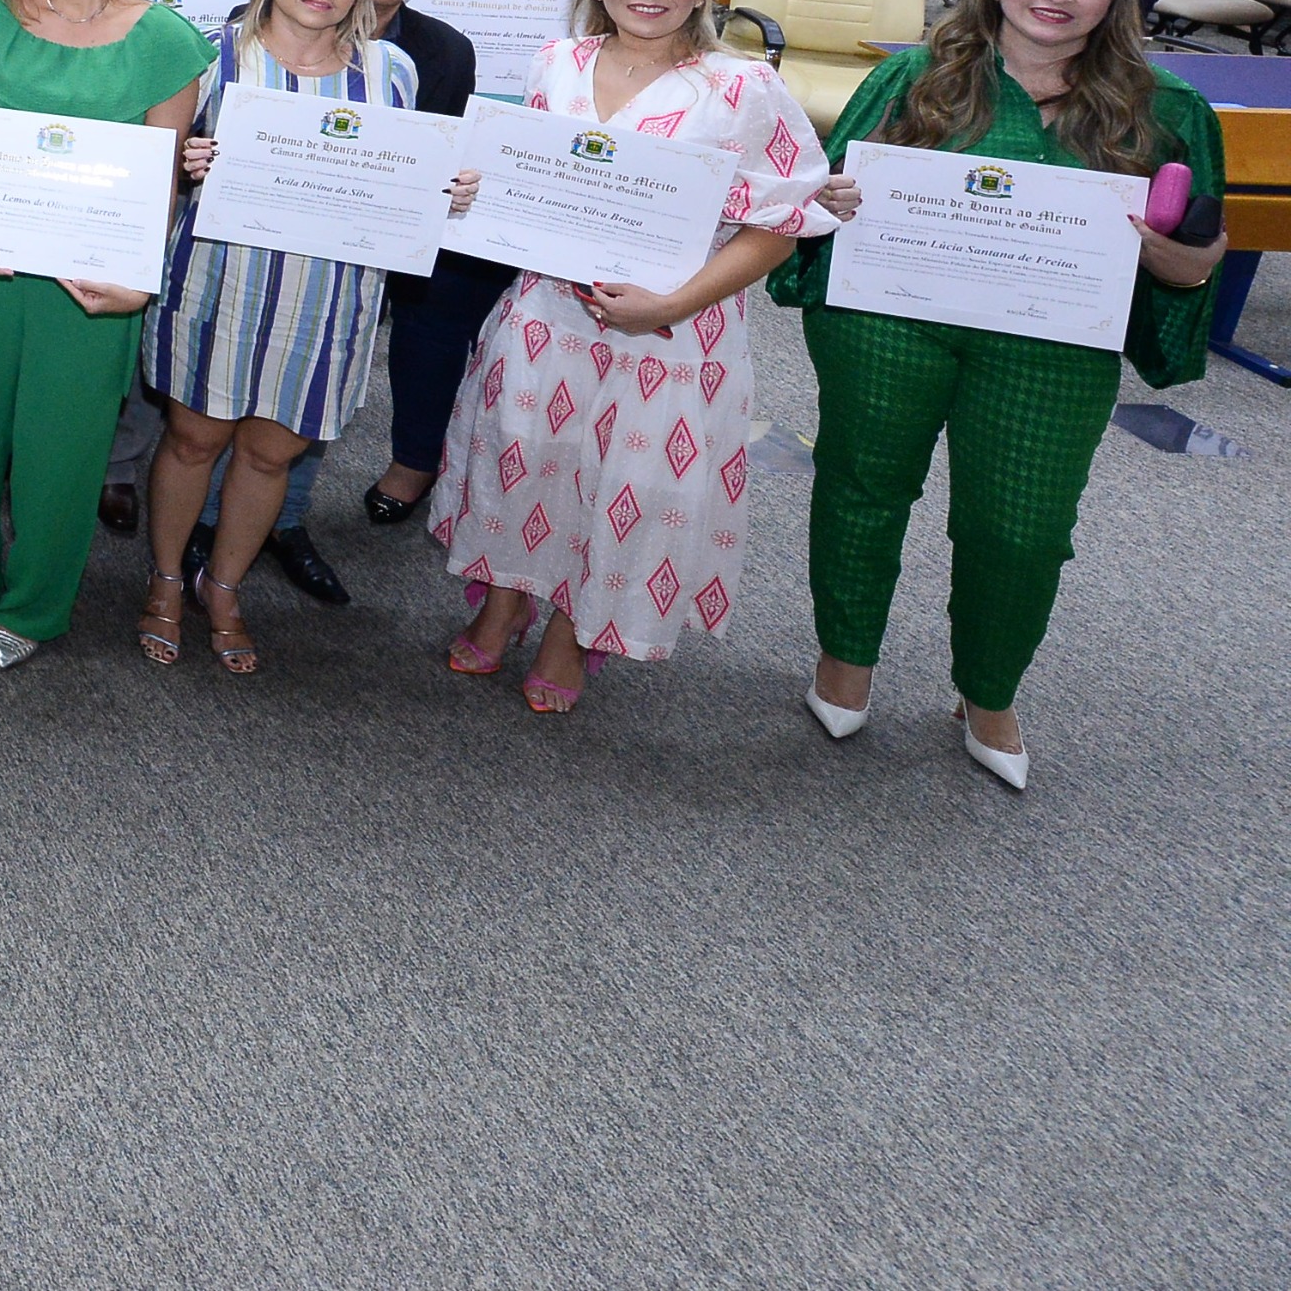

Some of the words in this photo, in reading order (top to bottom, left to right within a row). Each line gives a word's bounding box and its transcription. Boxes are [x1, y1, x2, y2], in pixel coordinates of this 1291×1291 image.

[274, 176, 299, 187] Keila
[301, 180, 333, 192] Divina
[336, 186, 347, 195] da
[349, 188, 375, 200] Silva
[506, 188, 536, 203] Kênia
[538, 194, 578, 211] Lamara
[581, 204, 608, 219] Silva
[611, 211, 643, 228] Braga
[880, 232, 927, 248] Carmem
[931, 238, 963, 253] Lúcia
[966, 244, 1016, 262] Santana
[1018, 252, 1033, 263] de
[1035, 254, 1079, 271] Freitas
